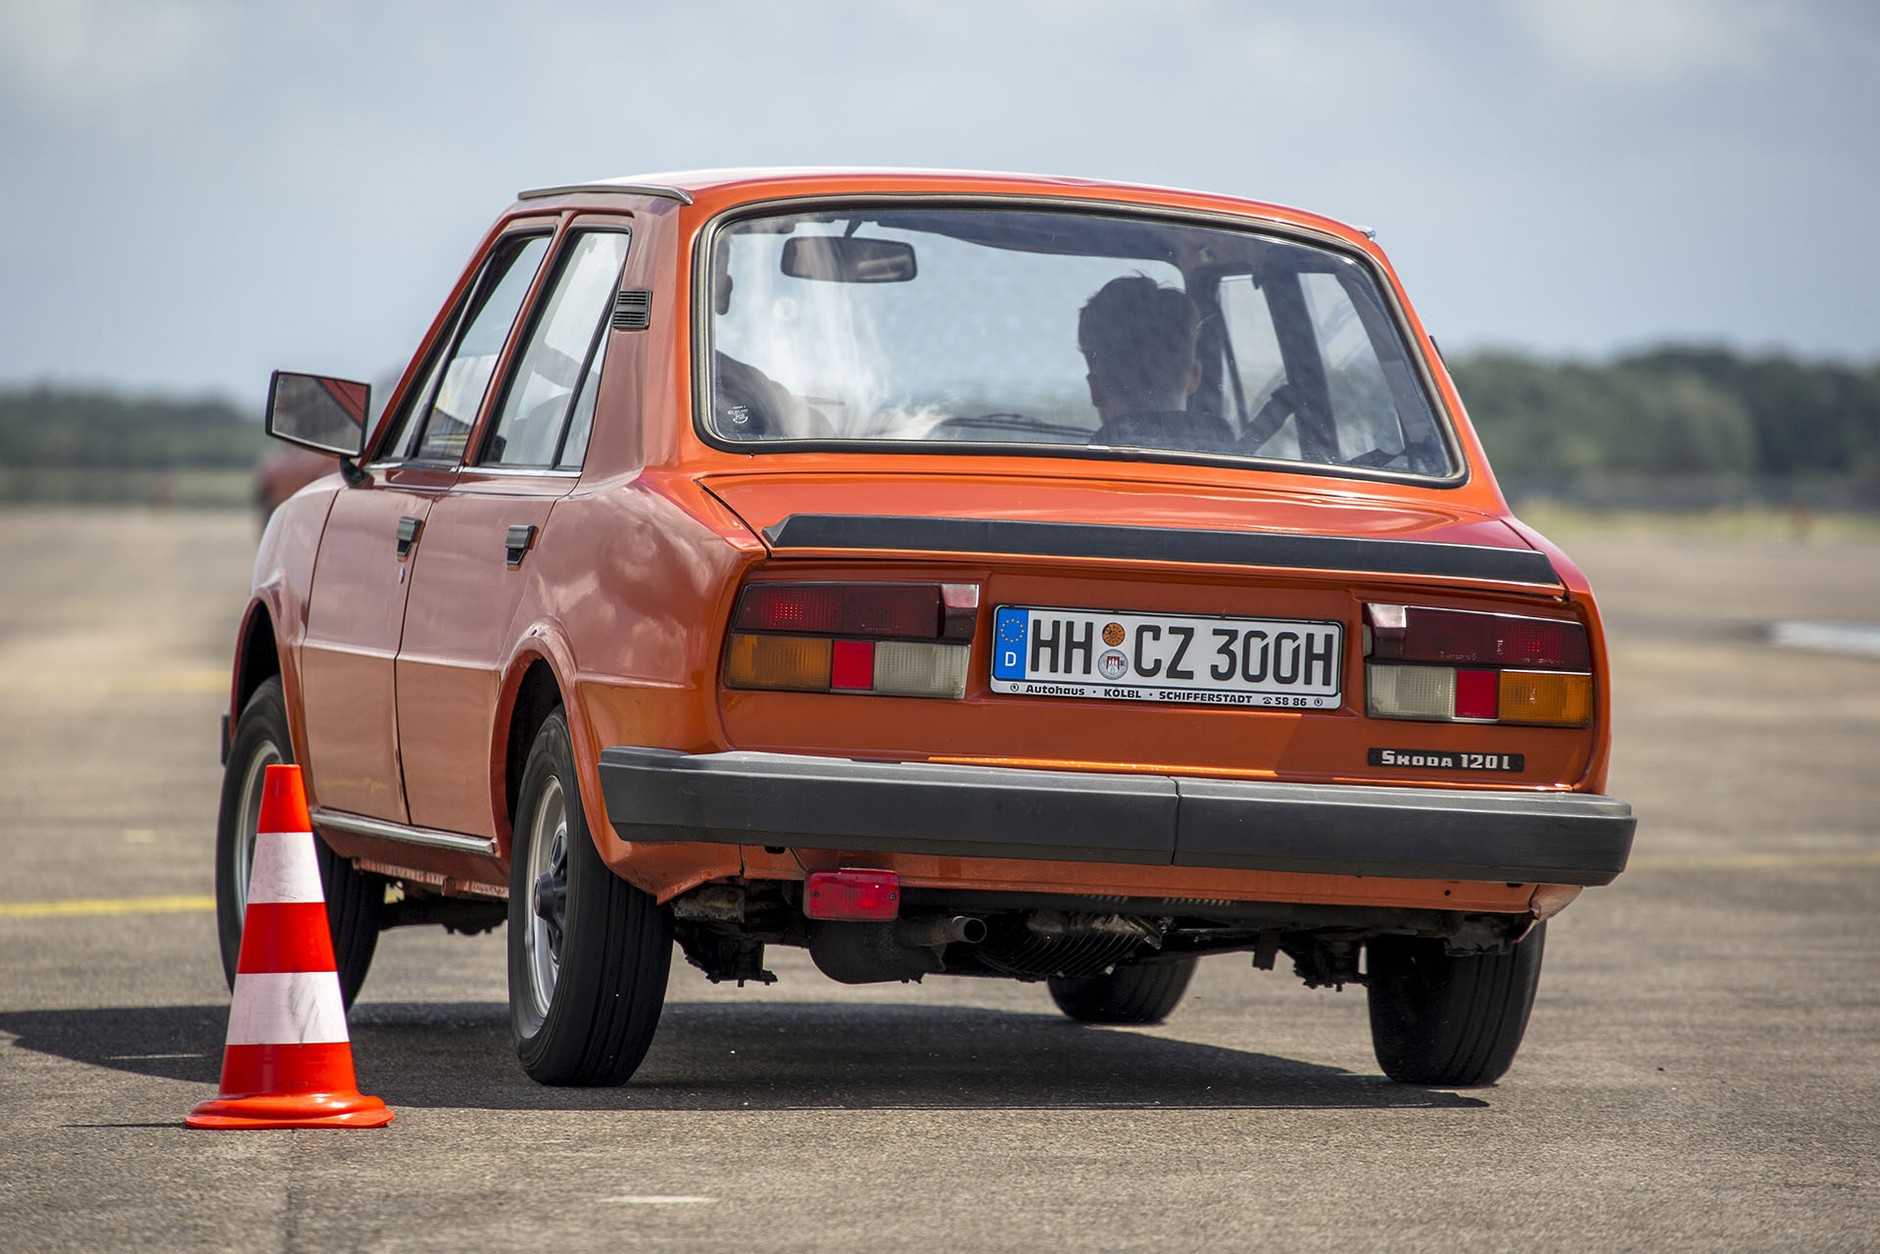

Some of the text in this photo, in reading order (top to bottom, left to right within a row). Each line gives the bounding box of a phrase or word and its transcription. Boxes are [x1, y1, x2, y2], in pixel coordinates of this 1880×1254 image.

[1004, 651, 1017, 667] D
[1031, 619, 1334, 686] HH CZ 300H
[1026, 685, 1085, 696] Autohaus
[1159, 691, 1253, 704] SCHIFFERSTADT
[1275, 697, 1289, 706] 58
[1293, 698, 1307, 707] 86
